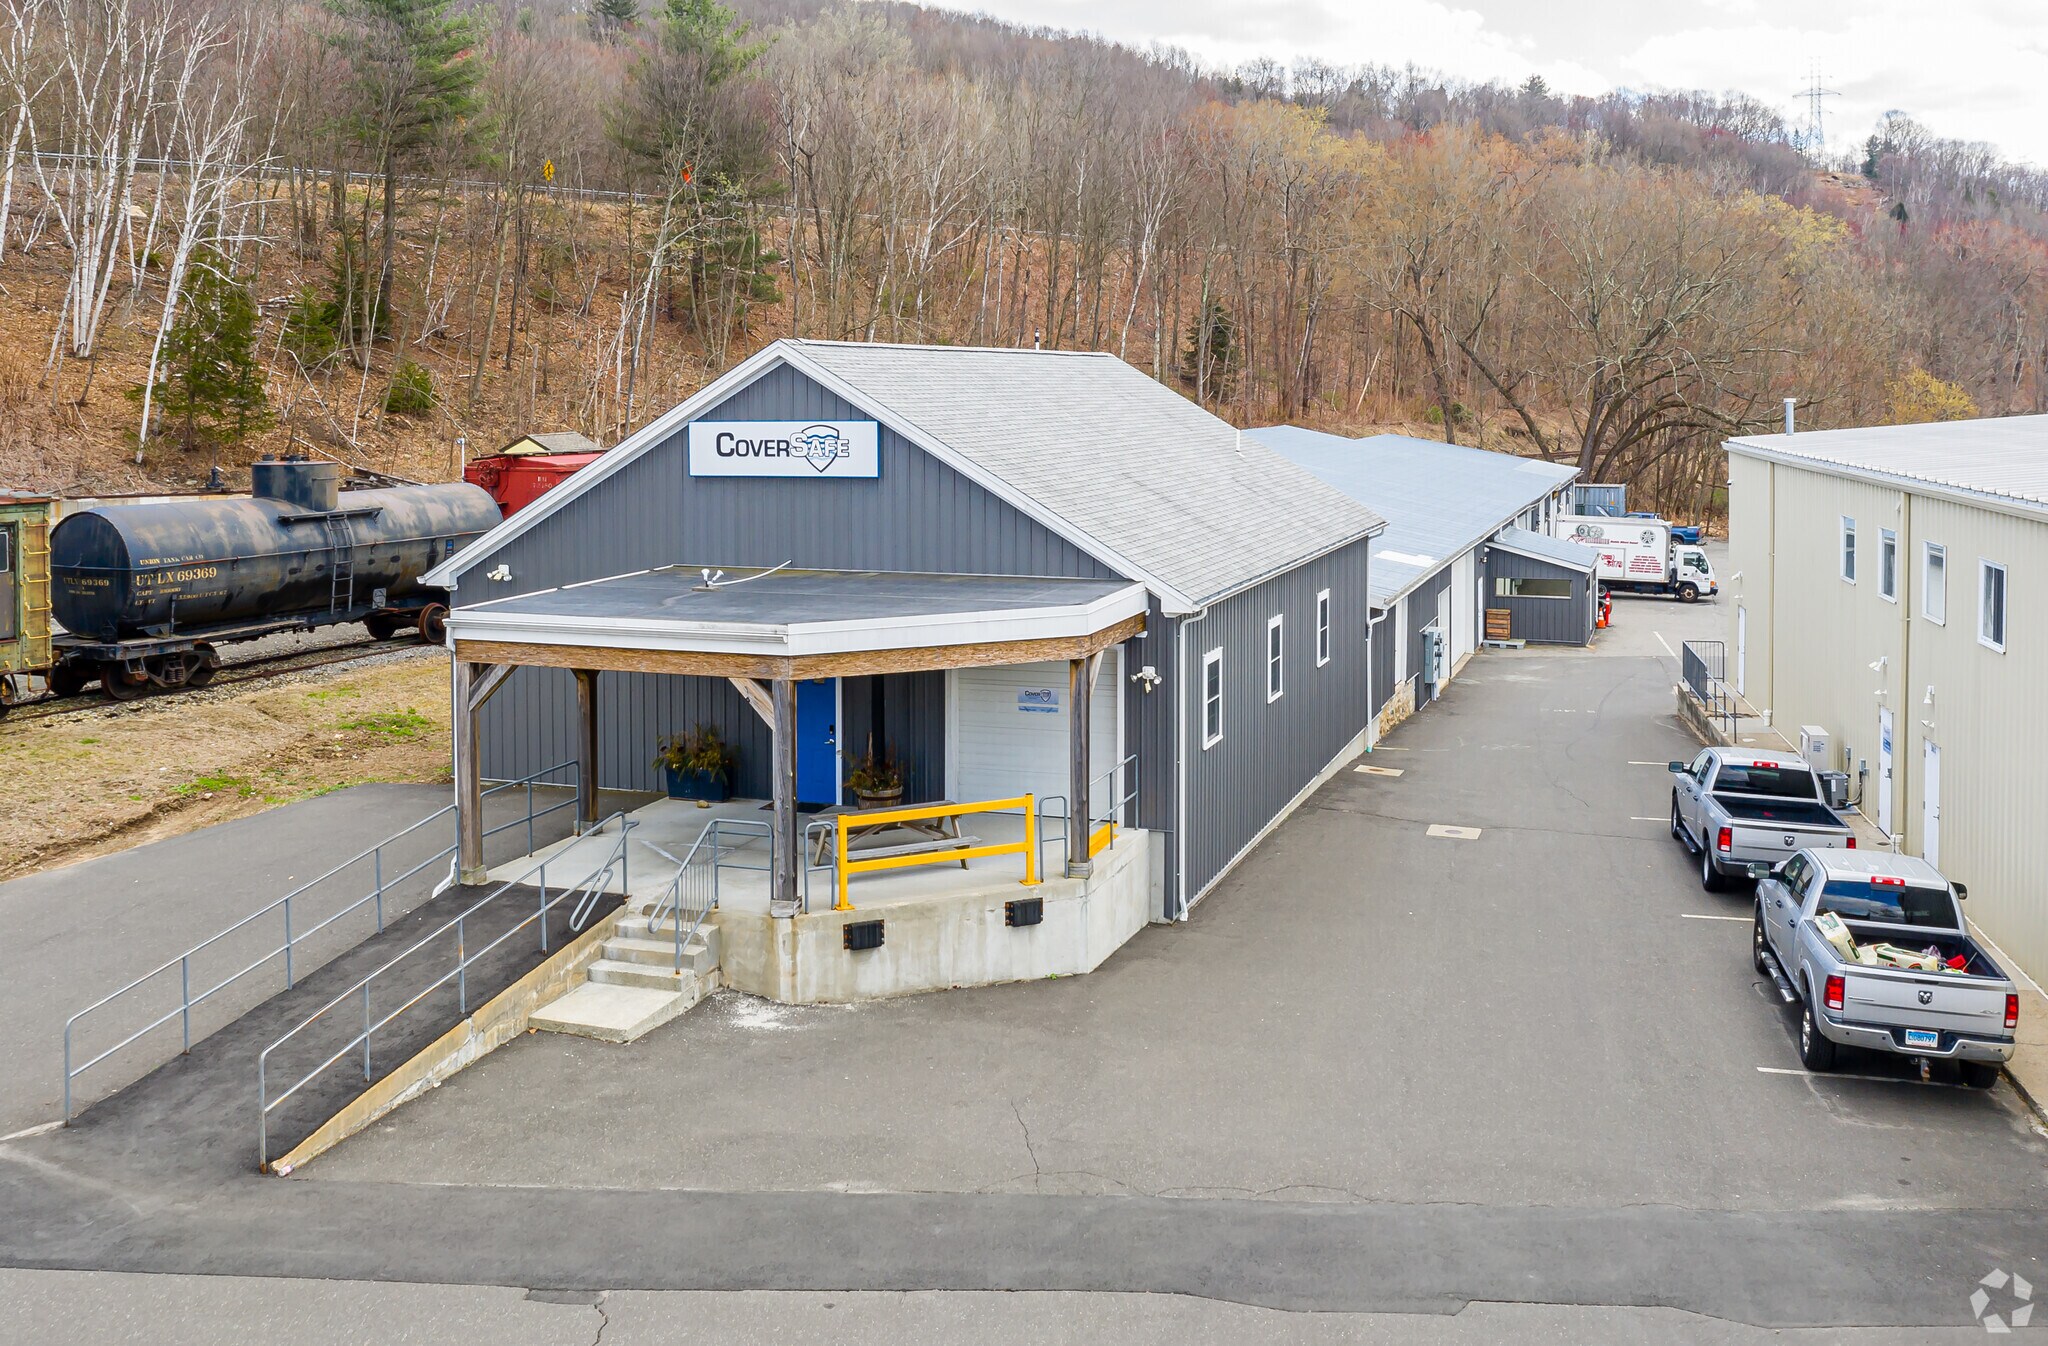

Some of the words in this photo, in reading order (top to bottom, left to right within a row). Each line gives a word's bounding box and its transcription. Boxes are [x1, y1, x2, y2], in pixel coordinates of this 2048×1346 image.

[716, 431, 850, 458] COVERSAFE
[177, 566, 217, 582] 69369
[81, 578, 110, 587] 69369
